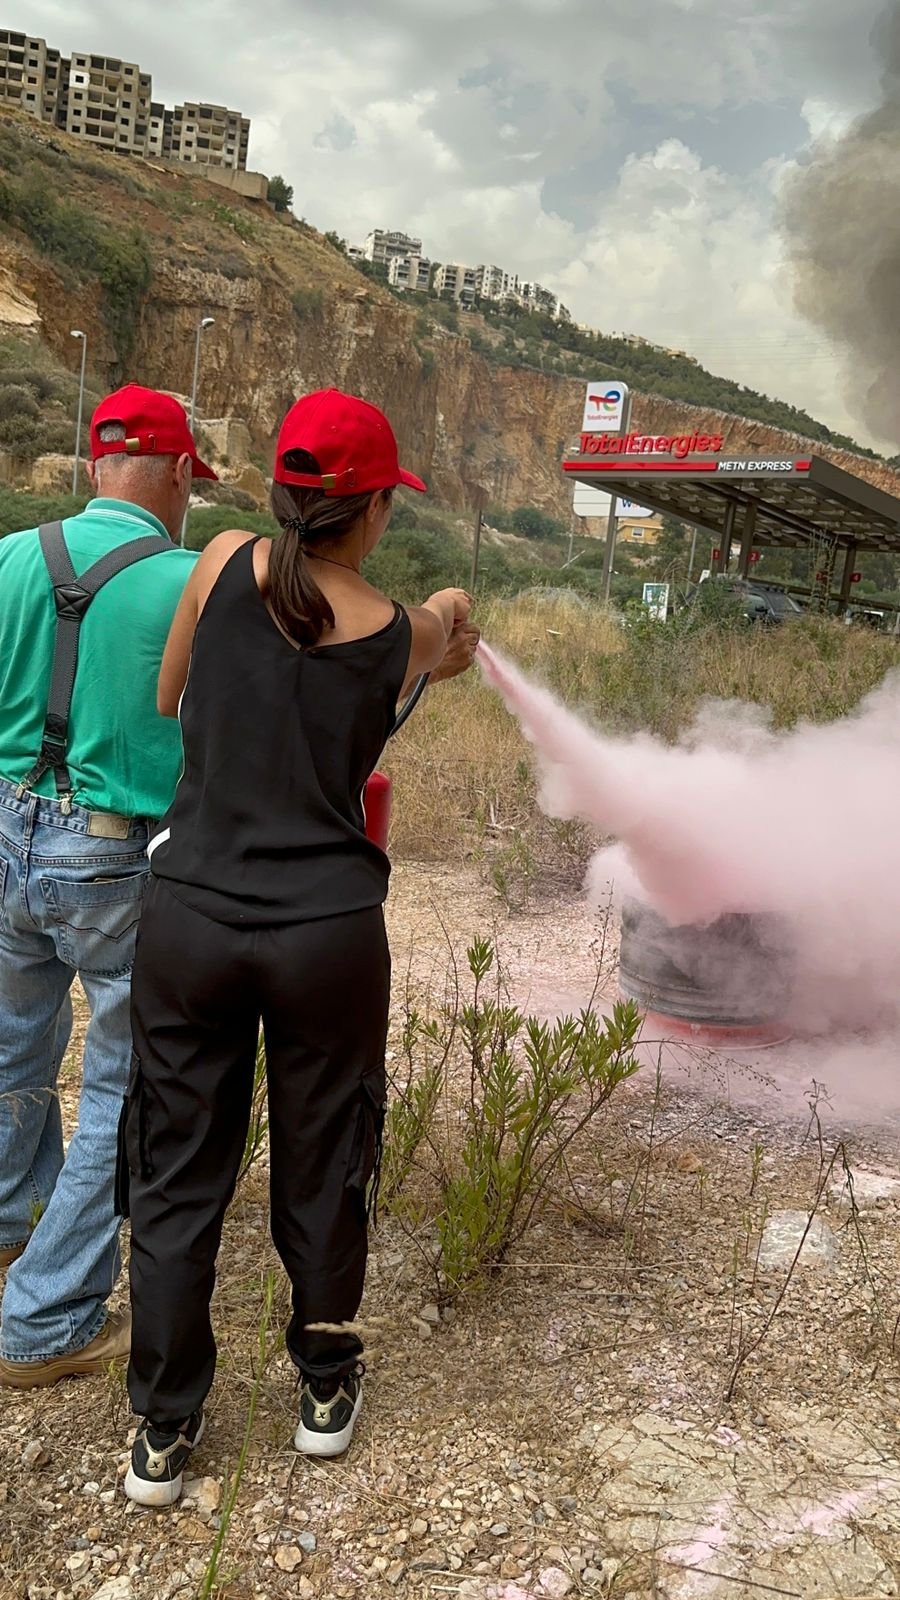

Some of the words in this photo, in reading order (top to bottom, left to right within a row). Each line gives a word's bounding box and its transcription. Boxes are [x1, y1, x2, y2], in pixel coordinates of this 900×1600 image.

[579, 431, 723, 458] TotalEnergies
[718, 460, 746, 471] METN
[747, 460, 793, 472] EXPRESS
